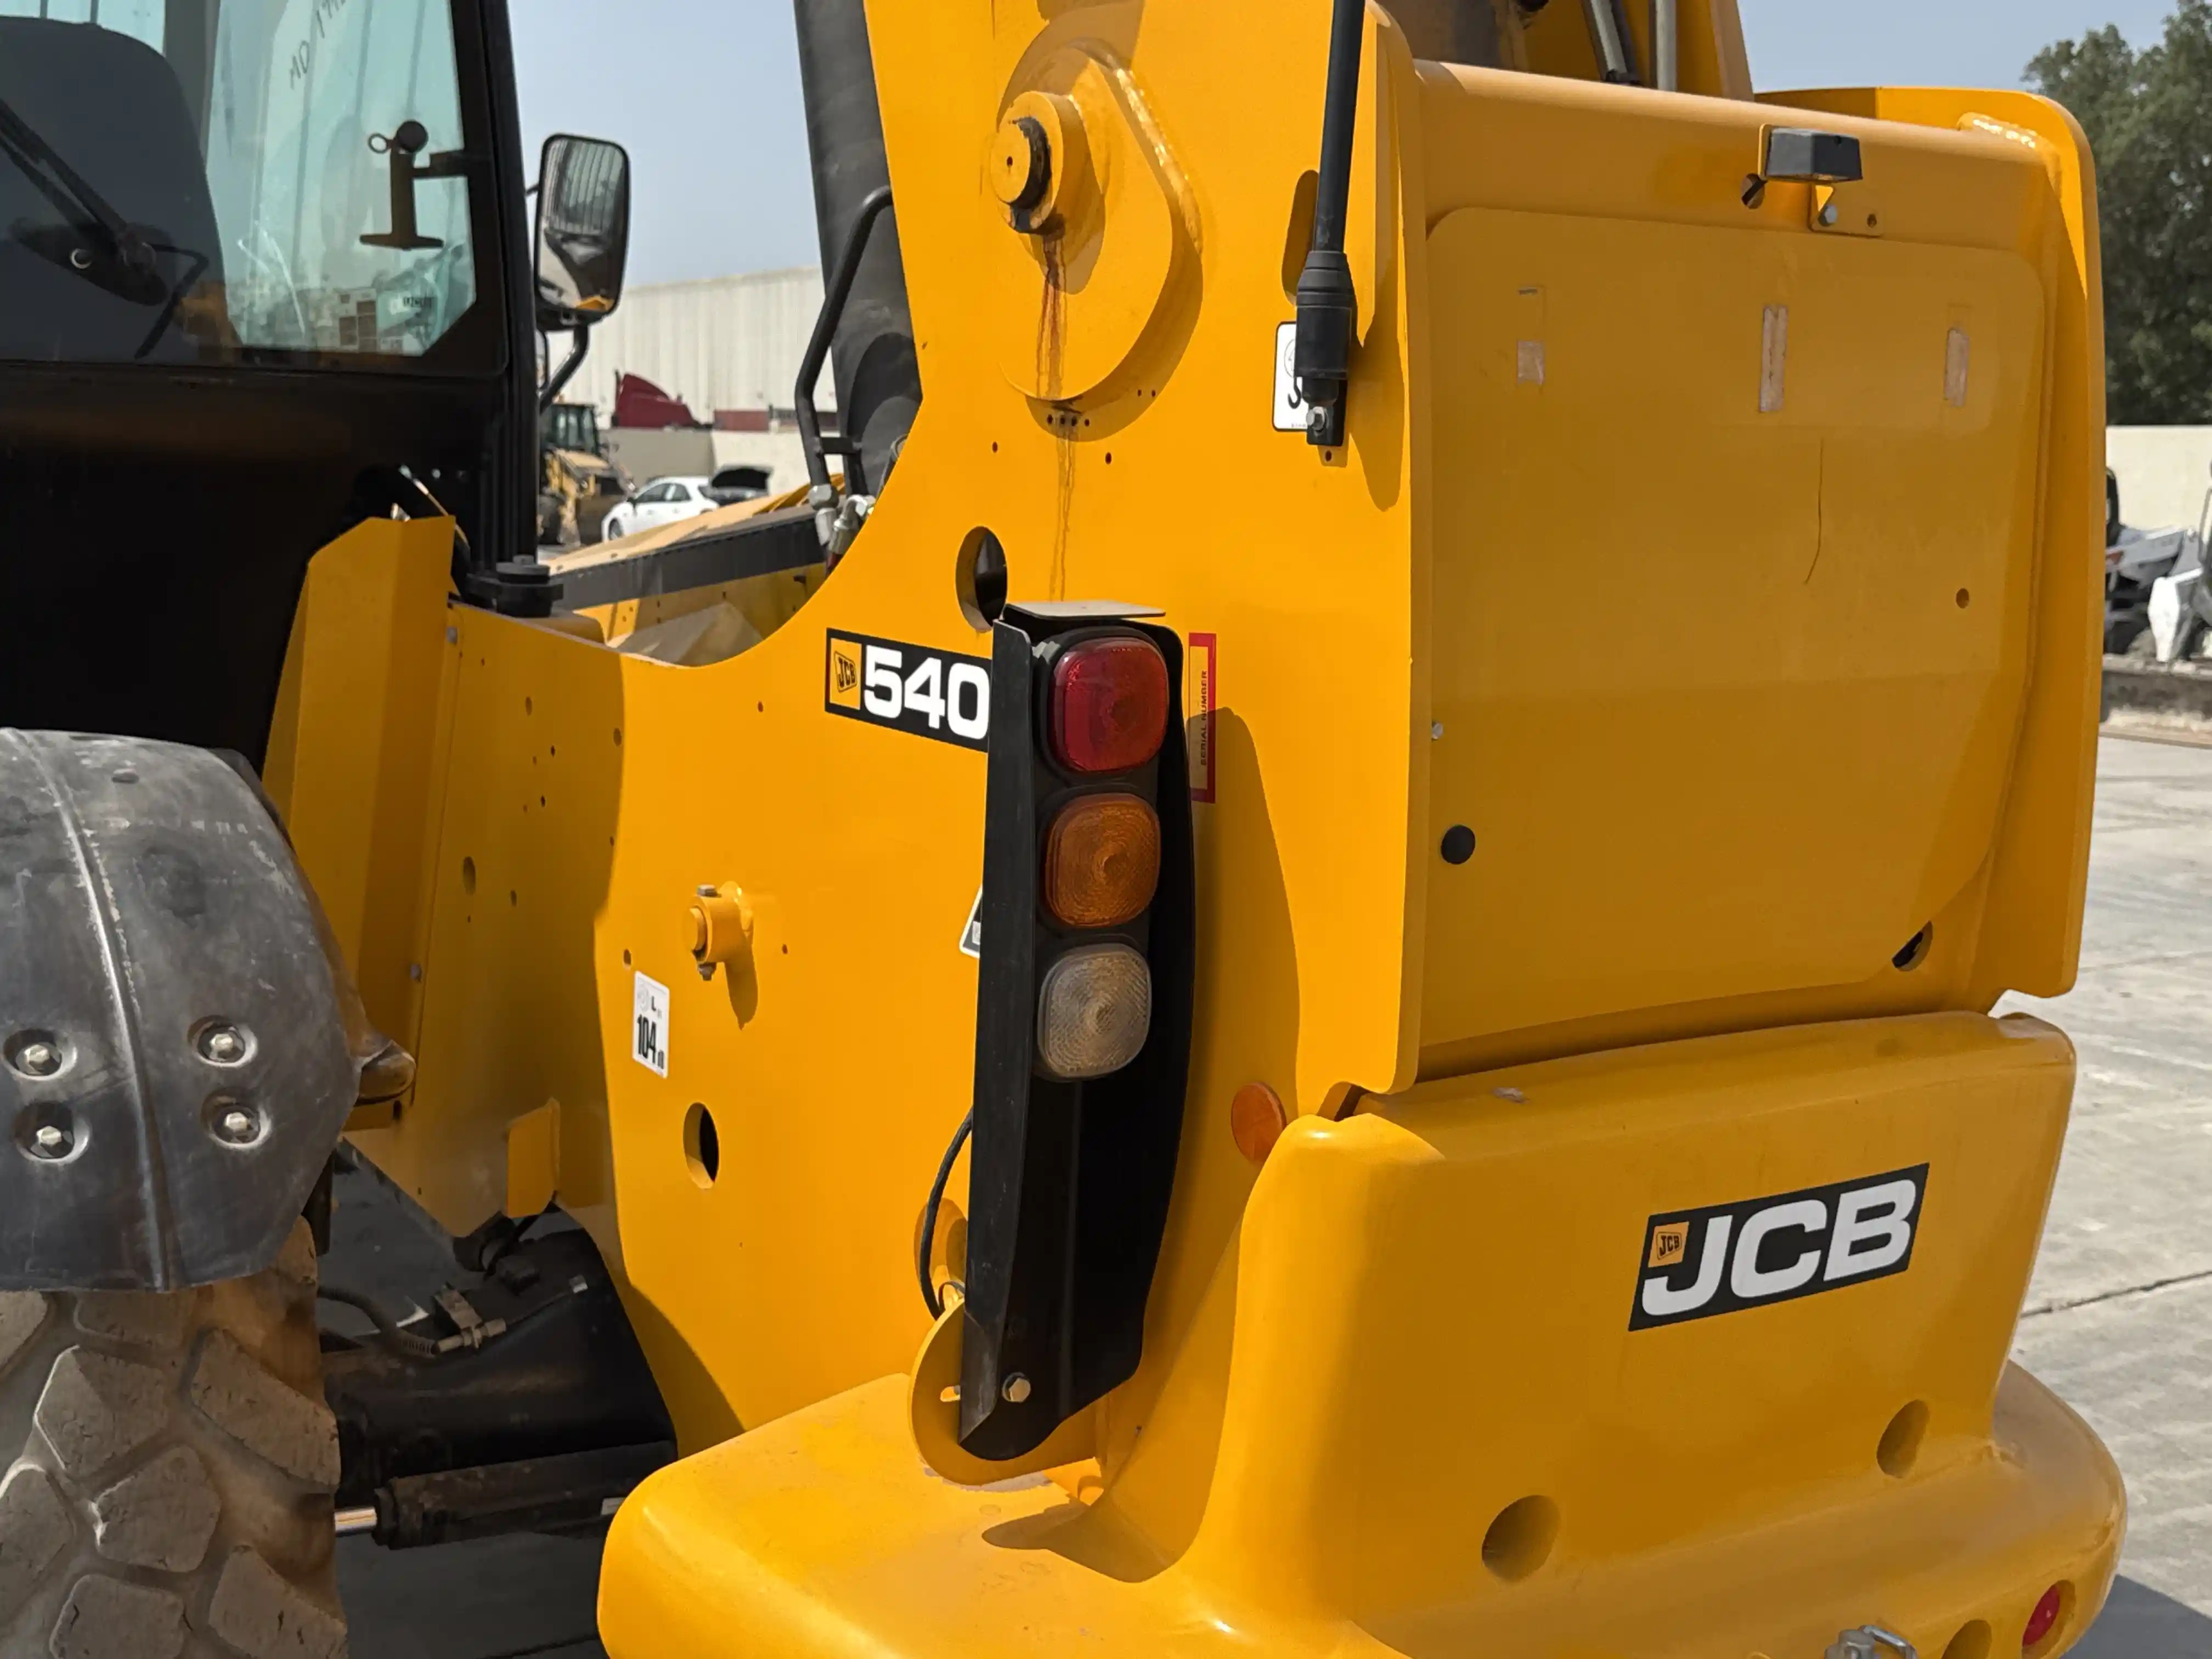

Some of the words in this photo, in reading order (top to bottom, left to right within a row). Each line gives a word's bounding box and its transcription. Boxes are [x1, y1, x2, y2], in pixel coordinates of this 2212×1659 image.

[838, 656, 856, 689] JCB
[864, 645, 990, 740] 540
[637, 1013, 657, 1064] 104
[1642, 1179, 1916, 1316] JCB
[1659, 1234, 1680, 1257] JCB
